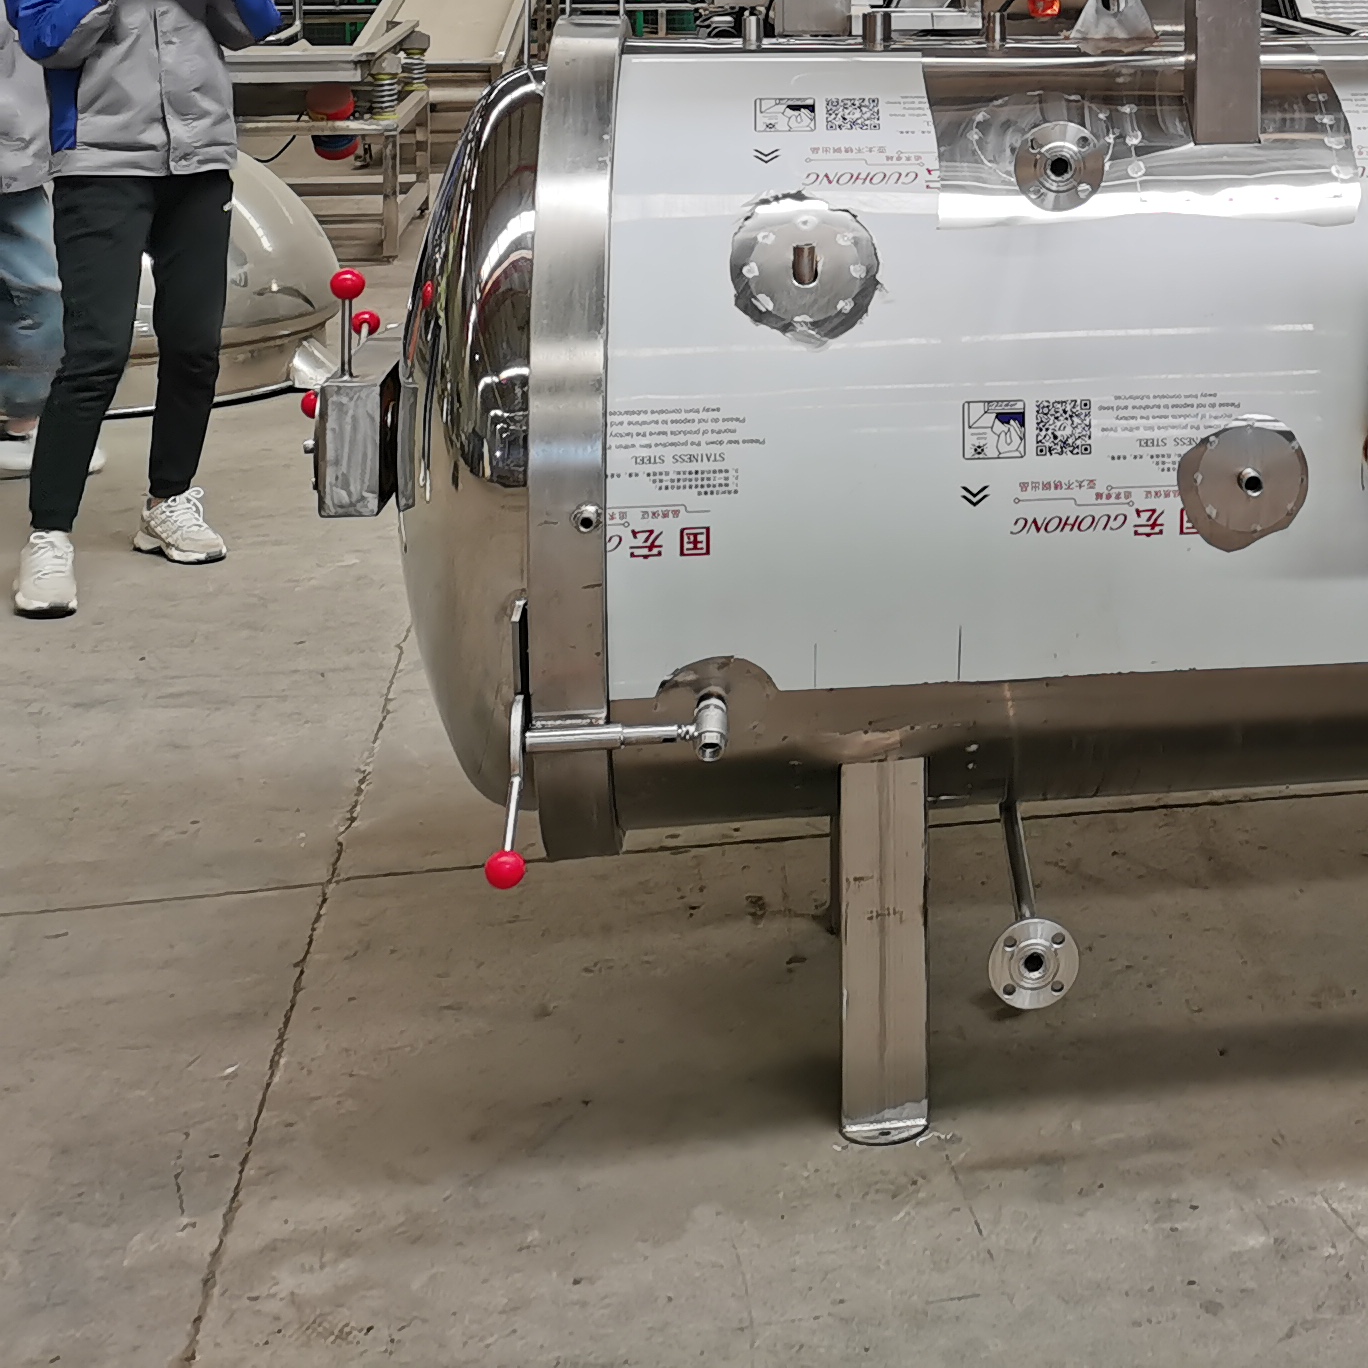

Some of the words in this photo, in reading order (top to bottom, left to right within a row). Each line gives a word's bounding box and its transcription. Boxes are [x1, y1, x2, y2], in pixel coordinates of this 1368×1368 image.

[802, 171, 918, 186] GUOHONG
[1136, 438, 1167, 448] STEEL
[631, 454, 665, 466] STEEL
[672, 452, 725, 464] STAINESS
[1018, 479, 1097, 492] 亚太不锈钢出品
[640, 509, 680, 520] 品质保证
[1010, 513, 1127, 535] GUOHONG
[629, 527, 710, 560] 国宏
